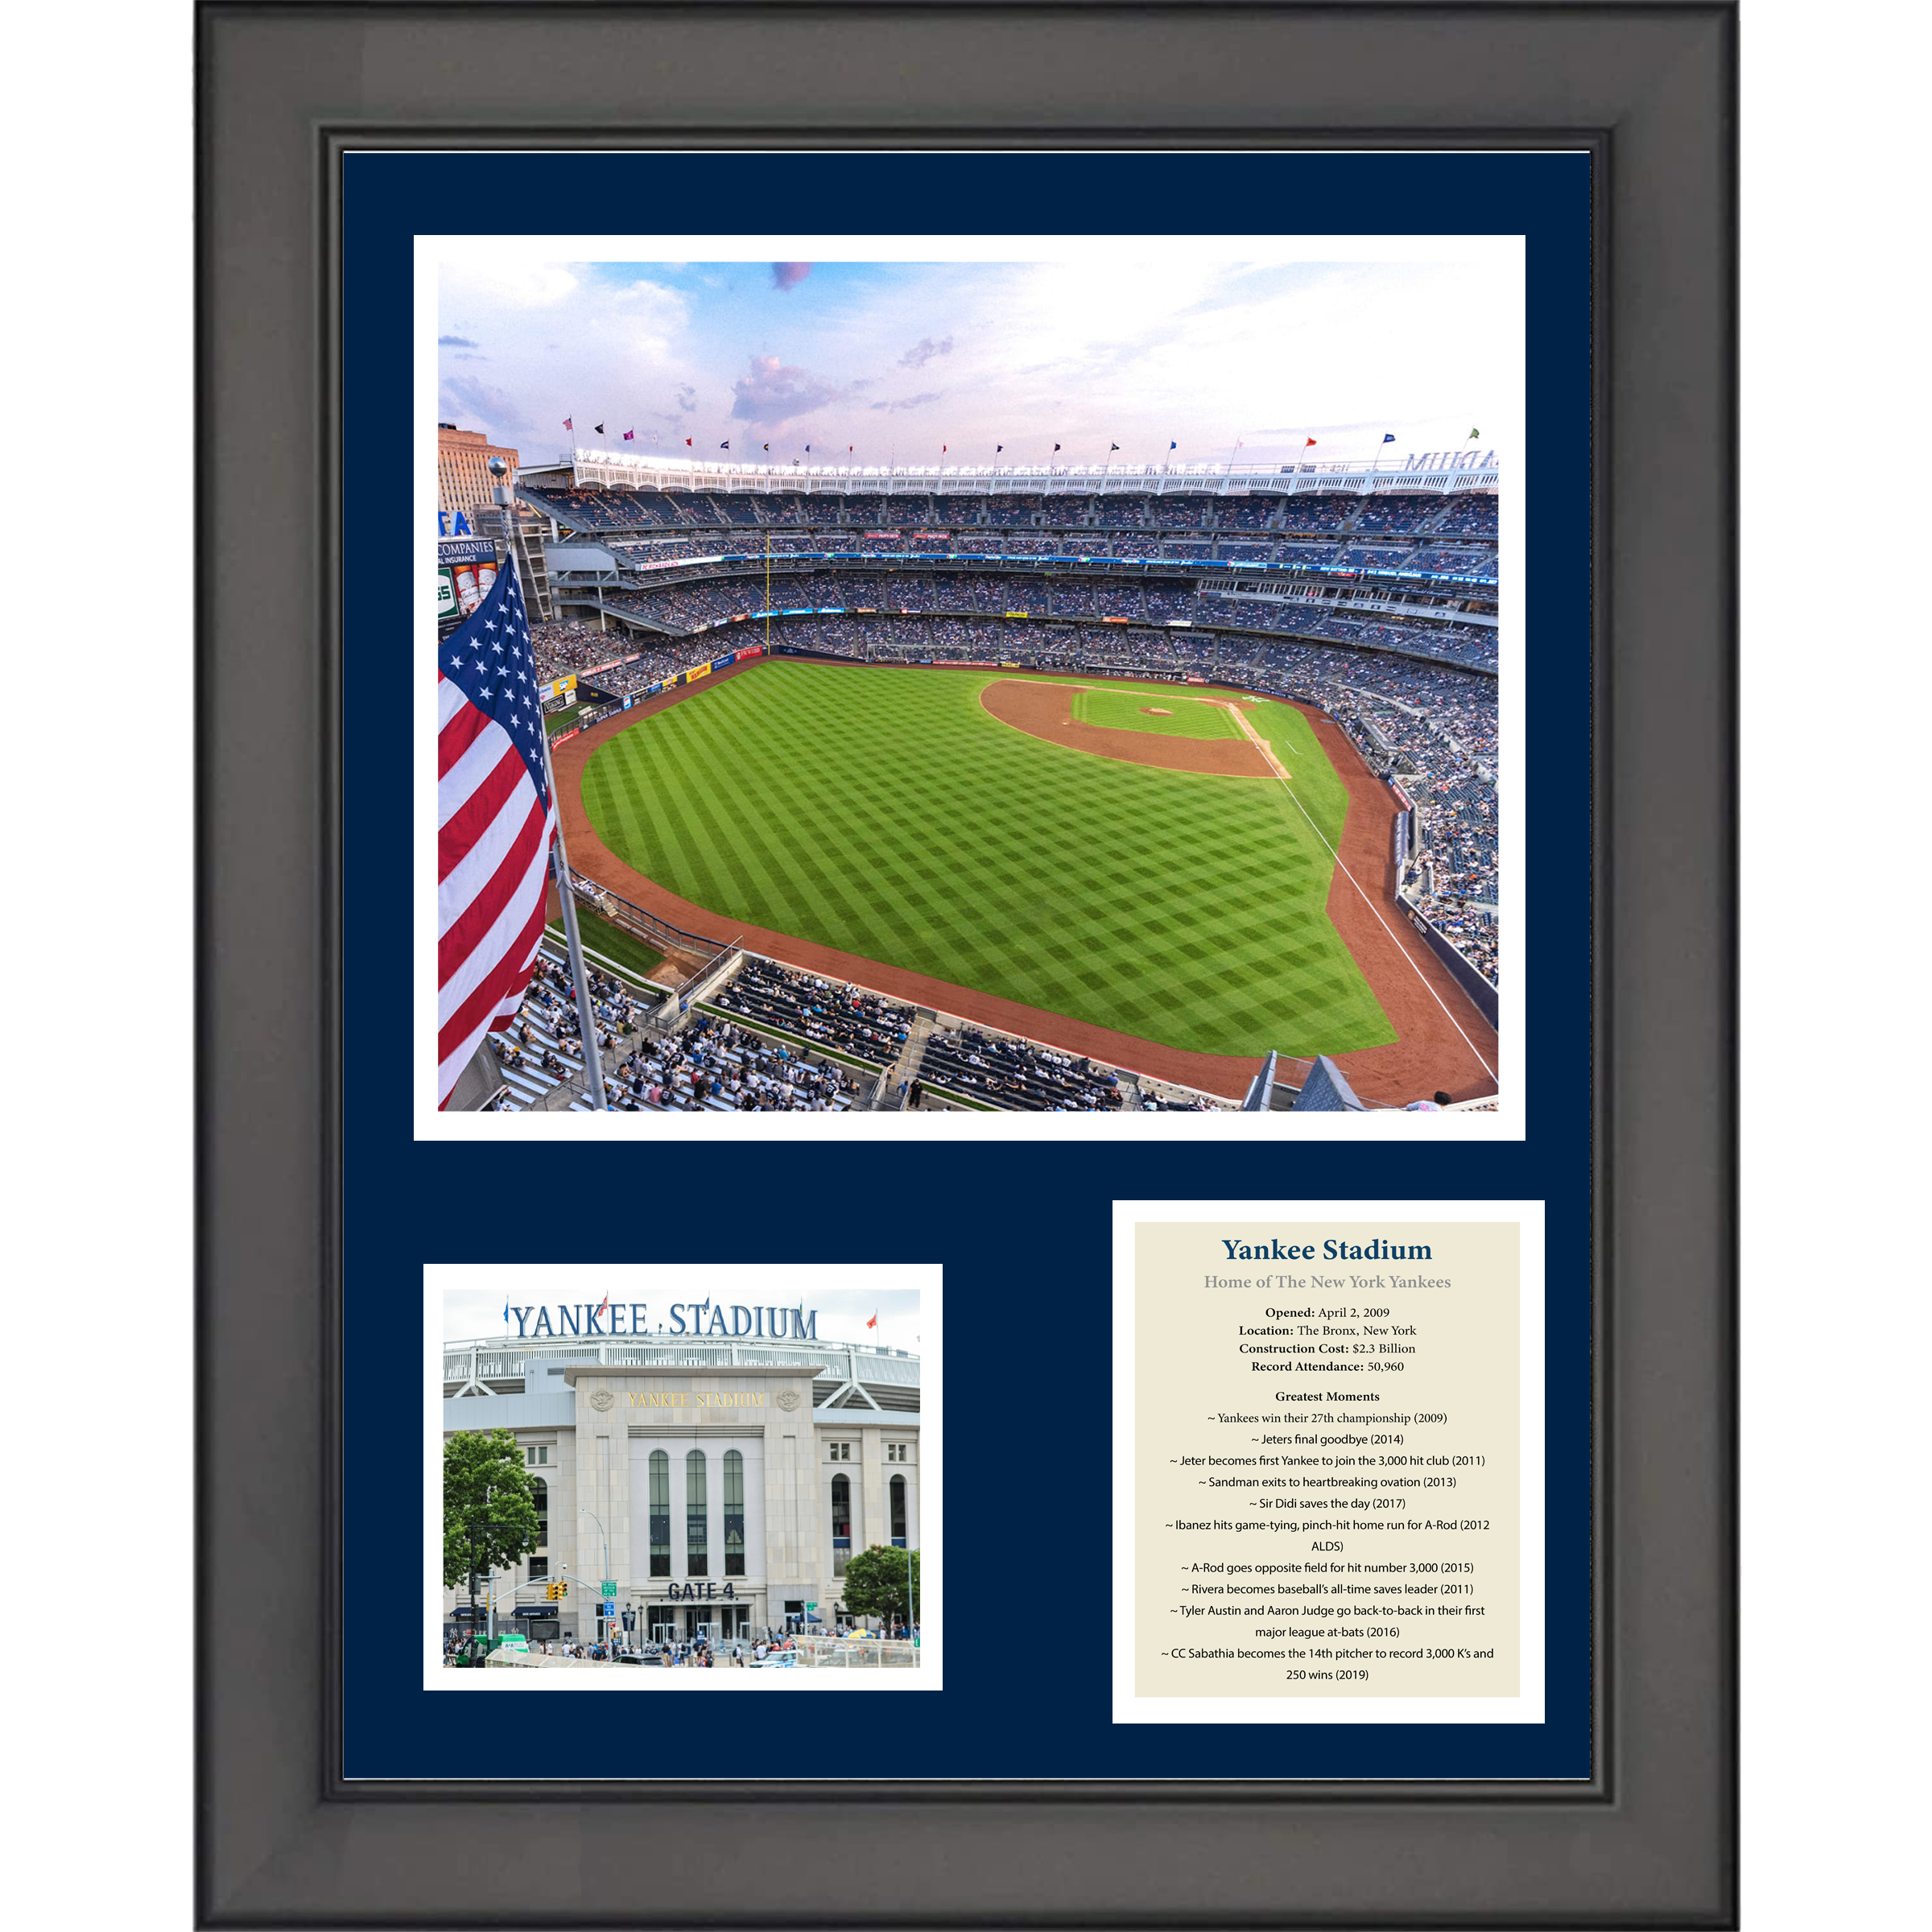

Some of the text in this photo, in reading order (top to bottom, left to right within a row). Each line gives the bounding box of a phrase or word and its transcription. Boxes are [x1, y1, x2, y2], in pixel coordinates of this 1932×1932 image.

[438, 541, 493, 556] COMPANIES
[445, 555, 477, 564] INSURANCE
[1220, 1238, 1433, 1261] Yankee Stadium
[1204, 1274, 1451, 1288] Home of The New York Yankees
[510, 1302, 819, 1340] YANKEE STADIUM
[1265, 1307, 1390, 1321] Opened: April 2, 2009
[1238, 1324, 1418, 1337] Location: The Bronx, New York
[1239, 1343, 1416, 1355] Construction Cost: $2.3 Billion
[1251, 1360, 1405, 1373] Record Attendance: 50,960
[628, 1392, 764, 1407] YANKEE STADIUM
[1275, 1391, 1381, 1402] Greatest Moments
[1217, 1412, 1447, 1426] Yankees win their 27th championship (2009)
[1261, 1433, 1404, 1447] Jeters final goodbye (2014)
[1179, 1455, 1485, 1468] Jeter becomes first Yankee to join the 3,000 hit club (2011)
[1208, 1476, 1457, 1490] Sandman exits to heartbreaking ovation (2013)
[1259, 1497, 1406, 1511] Sir Didi saves the day (2017)
[1175, 1519, 1490, 1533] Ibanez hits game-tying, pinch-hit home run for A-Rod (2012
[1311, 1541, 1344, 1553] ALDS)
[1191, 1562, 1474, 1575] A-Rod goes opposite field for hit number 3,000 (2015)
[668, 1582, 735, 1600] GATE 4
[1191, 1583, 1224, 1595] Rivera
[1227, 1583, 1275, 1595] becomes
[1331, 1583, 1372, 1595] all-time
[1373, 1586, 1402, 1595] saves
[1405, 1583, 1439, 1595] leader
[1440, 1583, 1474, 1596] (2011)
[1179, 1604, 1485, 1618] Tyler Austin and Aaron Judge go back-to-back in their first
[1255, 1626, 1400, 1640] major league at-bats (2016)
[1170, 1648, 1187, 1659] CC
[1188, 1648, 1235, 1659] Sabathia
[1237, 1648, 1286, 1659] becomes
[1287, 1648, 1307, 1659] the
[1309, 1648, 1333, 1659] 14th
[1335, 1648, 1373, 1662] pitcher
[1375, 1649, 1387, 1659] to
[1389, 1648, 1423, 1659] record
[1426, 1648, 1455, 1660] 3,000
[1473, 1648, 1494, 1659] and
[1286, 1669, 1369, 1682] 250 wins (2019)
